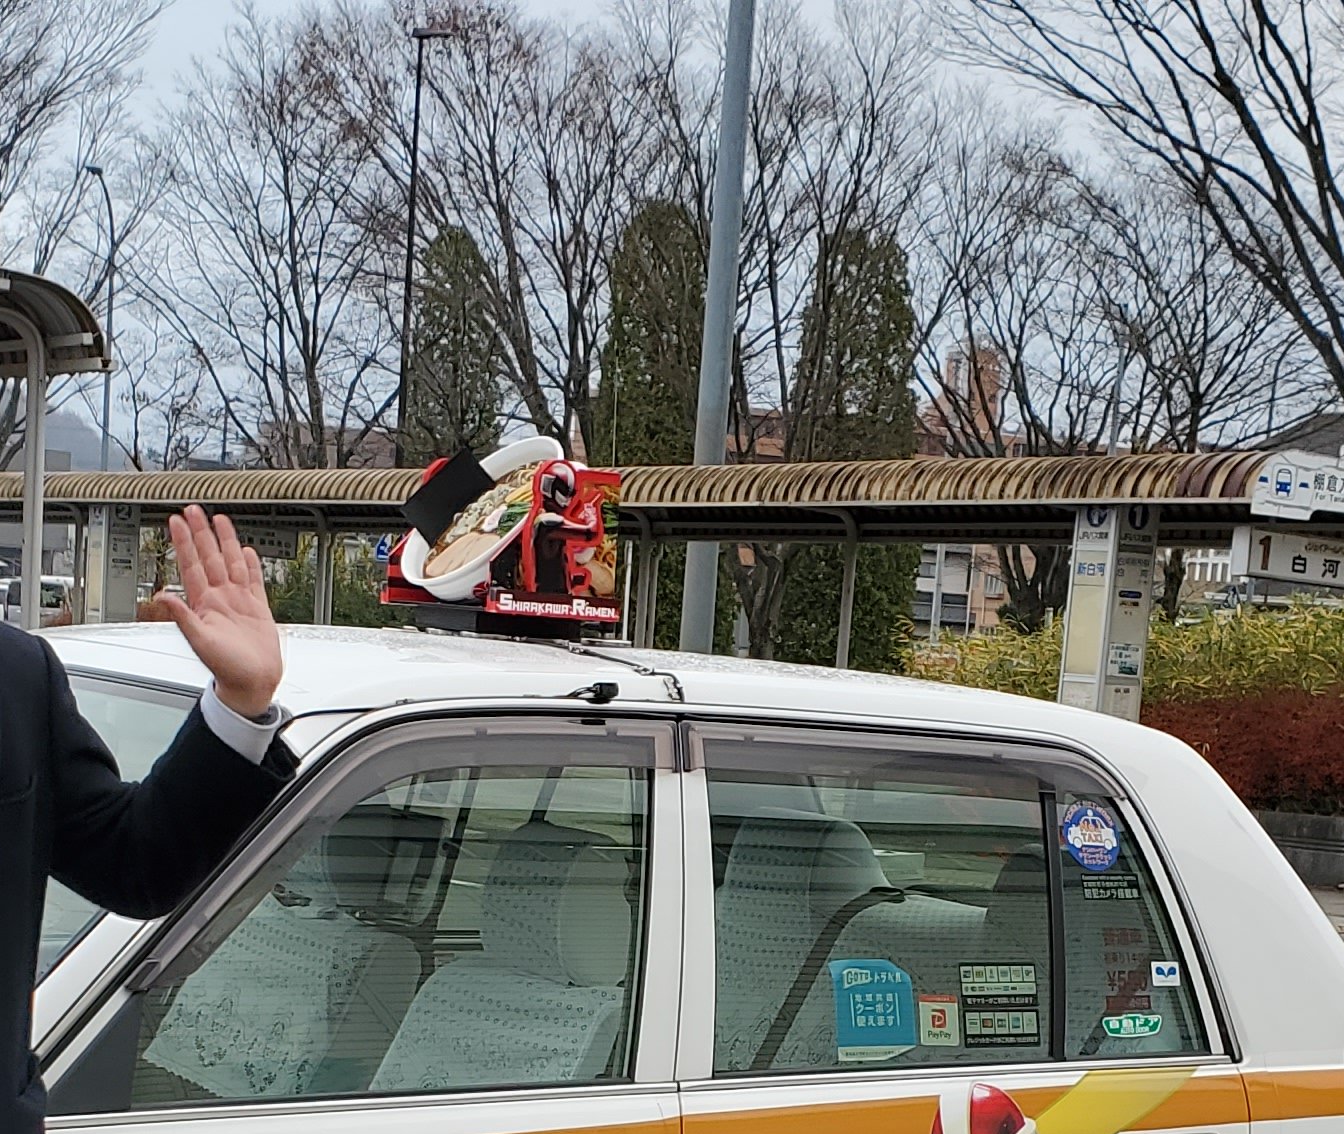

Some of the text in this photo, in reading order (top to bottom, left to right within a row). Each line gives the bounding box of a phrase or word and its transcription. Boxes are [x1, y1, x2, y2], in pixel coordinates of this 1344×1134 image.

[1258, 535, 1272, 571] 1
[1077, 562, 1106, 577] 新白河
[1081, 832, 1104, 843] TAXI
[873, 971, 902, 983] トラベル
[855, 1002, 894, 1015] クーポン
[856, 1014, 895, 1027] 使えます
[1109, 1017, 1159, 1029] 自動ドア
[927, 1030, 952, 1040] PayPay
